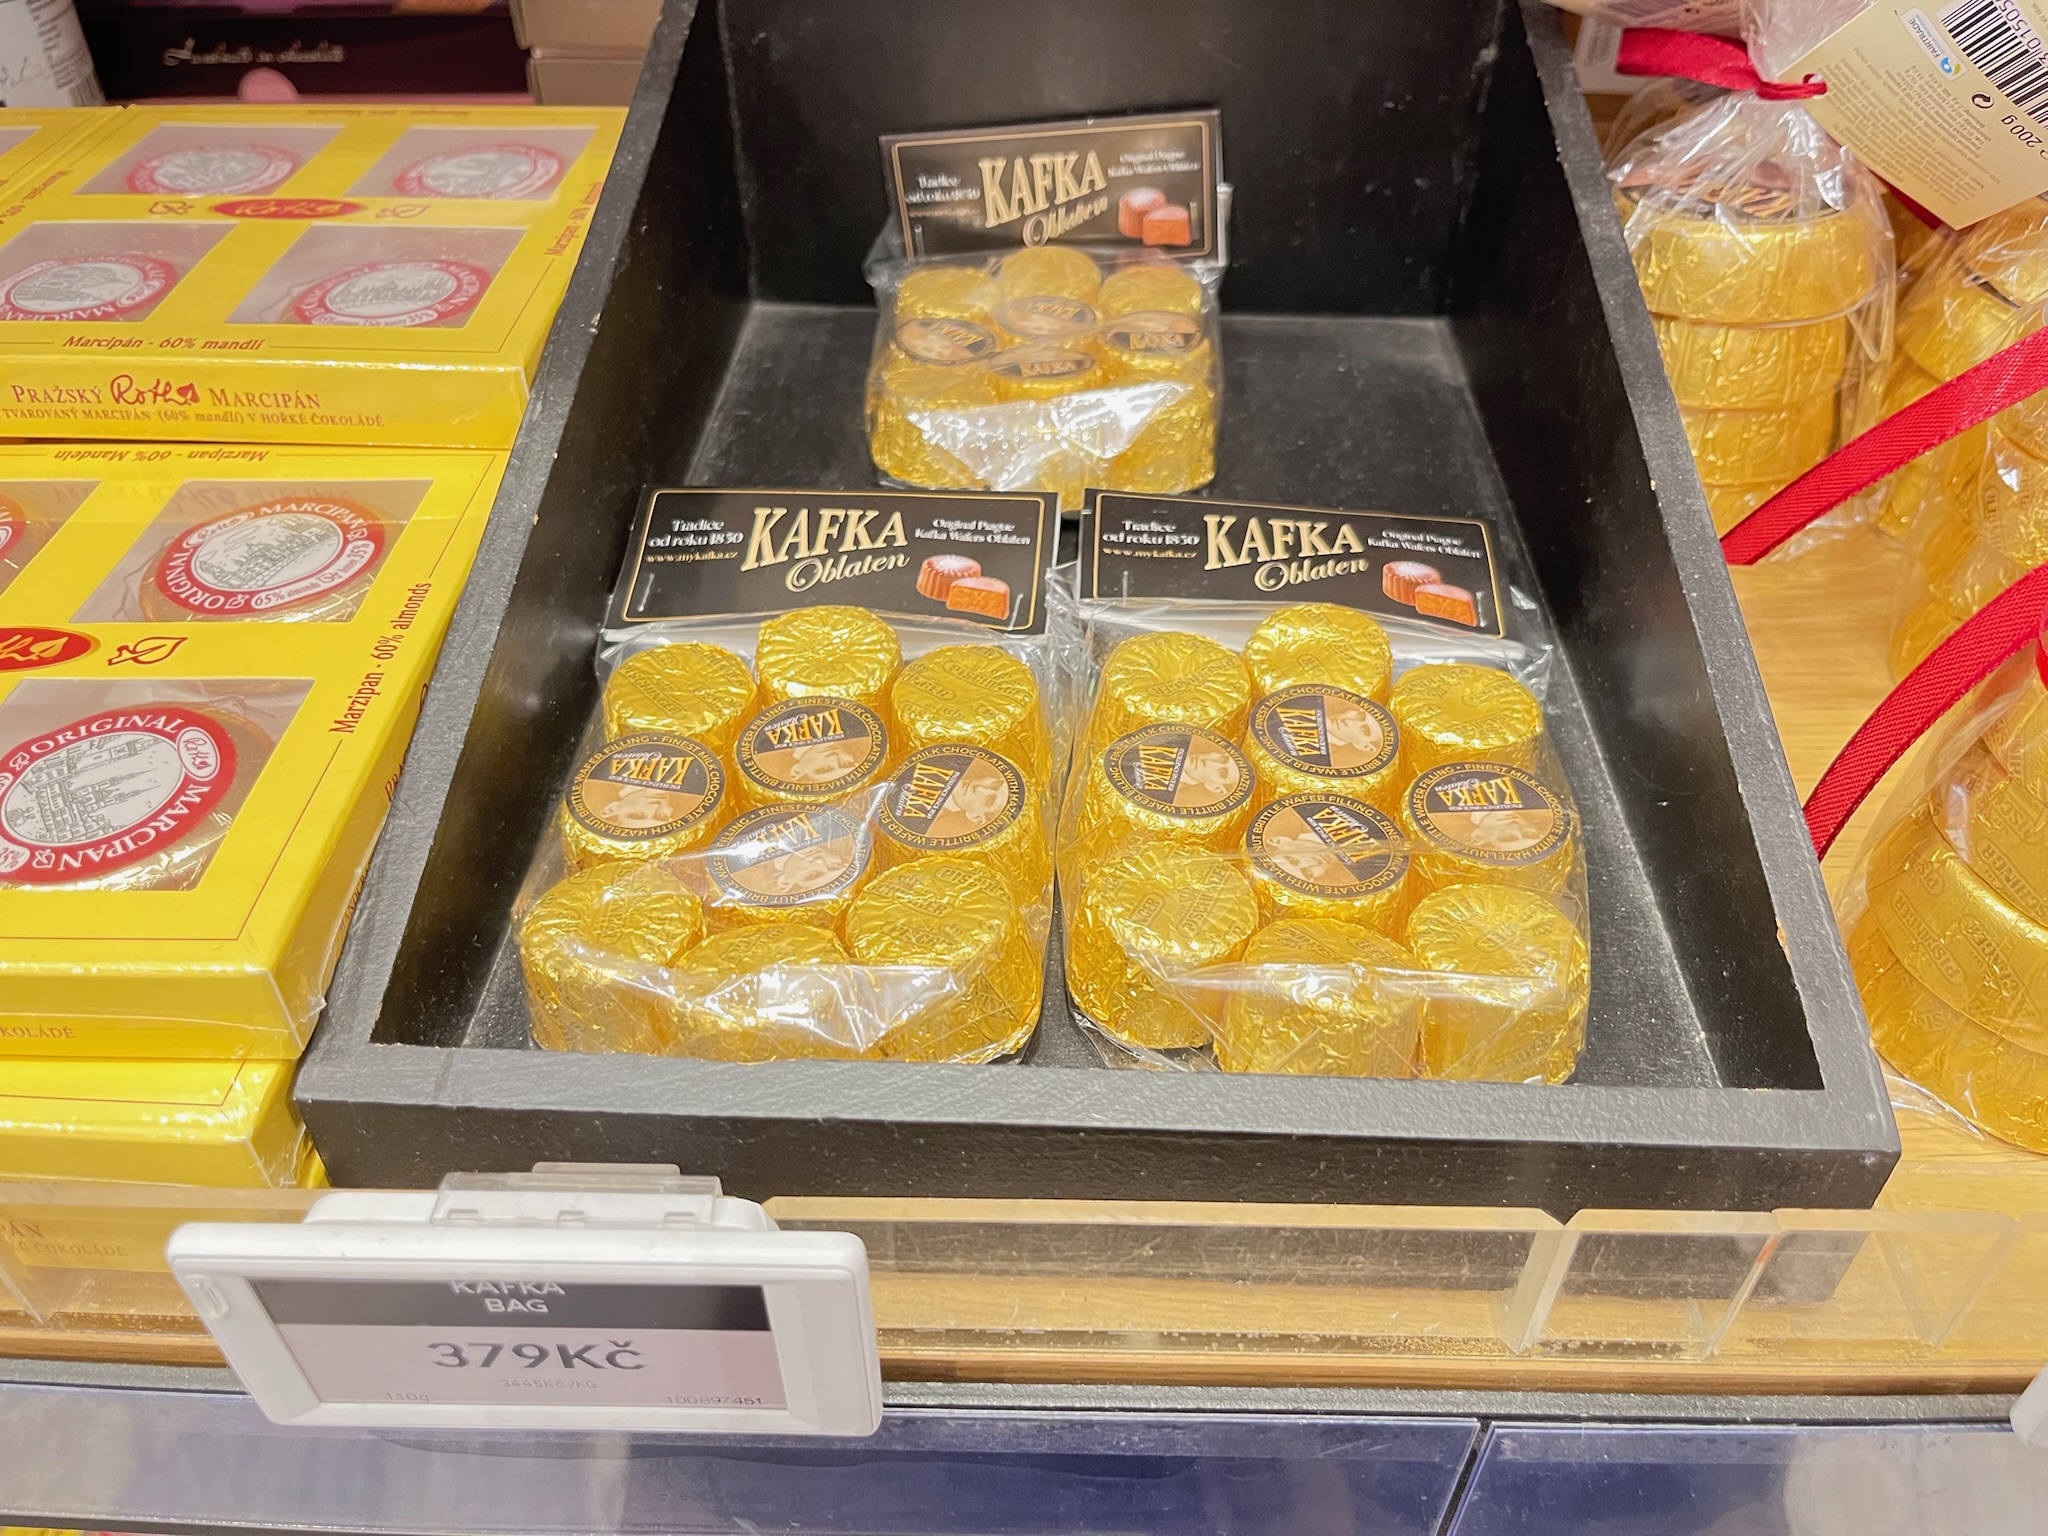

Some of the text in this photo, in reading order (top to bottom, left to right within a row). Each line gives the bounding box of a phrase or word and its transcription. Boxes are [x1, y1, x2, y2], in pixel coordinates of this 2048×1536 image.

[1908, 18, 1941, 58] FAIRTRADE
[977, 149, 1107, 229] KAFKA
[61, 336, 267, 350] Marcipán 60% mandlí
[11, 384, 103, 405] PRAŽSKÝ
[208, 387, 321, 409] MARCIPÁN
[4, 407, 78, 420] TVAROVANÝ
[82, 409, 150, 421] MARCIPÁN
[54, 448, 269, 462] Marzipan 60% Mandeln
[260, 502, 367, 529] MARCIPAN
[672, 519, 724, 532] Tradice
[933, 519, 976, 531] Original
[1122, 520, 1176, 532] Tradice
[648, 532, 744, 547] od roku 1850
[740, 507, 908, 572] KAFKA
[915, 528, 947, 540] Kafka
[986, 535, 1031, 545] Oblaten
[1102, 532, 1200, 545] od roku 1850
[1203, 514, 1364, 570] KAFKA
[1368, 537, 1398, 548] Kafka
[1438, 545, 1481, 558] Oblaten
[1382, 529, 1423, 542] Original
[646, 551, 738, 563] www.mykafka.cz
[1102, 548, 1198, 560] www.mykafka.cz
[166, 551, 225, 609] ORIGINAL
[254, 592, 285, 606] 65%
[347, 543, 371, 560] 35%
[785, 553, 910, 592] Oblaten
[1254, 558, 1368, 592] Oblaten
[329, 582, 433, 735] Marzipan 60% almonds
[30, 714, 185, 753] ORIGINAL
[765, 708, 844, 745] KAFKA
[1255, 687, 1394, 776] FINEST MILK CHOCOLATE WITH HAZELNUT BRITTLE WAFER FILLING
[1275, 707, 1321, 756] KAFKA
[741, 697, 883, 792] FINEST MILK CHOCOLATE WITH HAZELNUT BRITTLE WAFER FILLING
[912, 748, 940, 762] MILK
[942, 746, 1008, 770] CHOCOLATE
[1109, 725, 1250, 815] FINEST MILK CHOCOLATE WITH HAZELNUT BRITTLE WAFER FILLING
[1138, 744, 1179, 791] KAFKA
[1465, 763, 1509, 773] FINEST
[610, 756, 696, 785] KAFKA
[1004, 769, 1019, 792] WITH
[1423, 765, 1455, 790] FILLING
[1509, 769, 1539, 788] MILK
[571, 735, 721, 837] FINEST MILK CHOCOLATE WITH HAZELNUT BRITTLE WAFER FILLING
[902, 762, 955, 818] KAFKA
[1436, 776, 1523, 807] KAFKA
[759, 804, 803, 816] FINEST
[805, 804, 835, 817] MILK
[1282, 795, 1326, 807] WAFER
[1328, 795, 1375, 818] FILLING
[1413, 788, 1425, 820] WAFER
[58, 783, 212, 872] MARCIPAN
[1257, 804, 1283, 834] BRITTLE
[716, 818, 750, 848] FILLING
[888, 822, 926, 846] WAFER
[1312, 808, 1390, 863] KAFKA
[1529, 835, 1557, 855] WITH
[1463, 846, 1531, 861] HAZELNUT
[1286, 875, 1320, 893] WITH
[1324, 871, 1395, 895] CHOCOLATE
[449, 1280, 567, 1296] KAFKA
[484, 1298, 549, 1313] BAG
[425, 1338, 649, 1371] 379Kč
